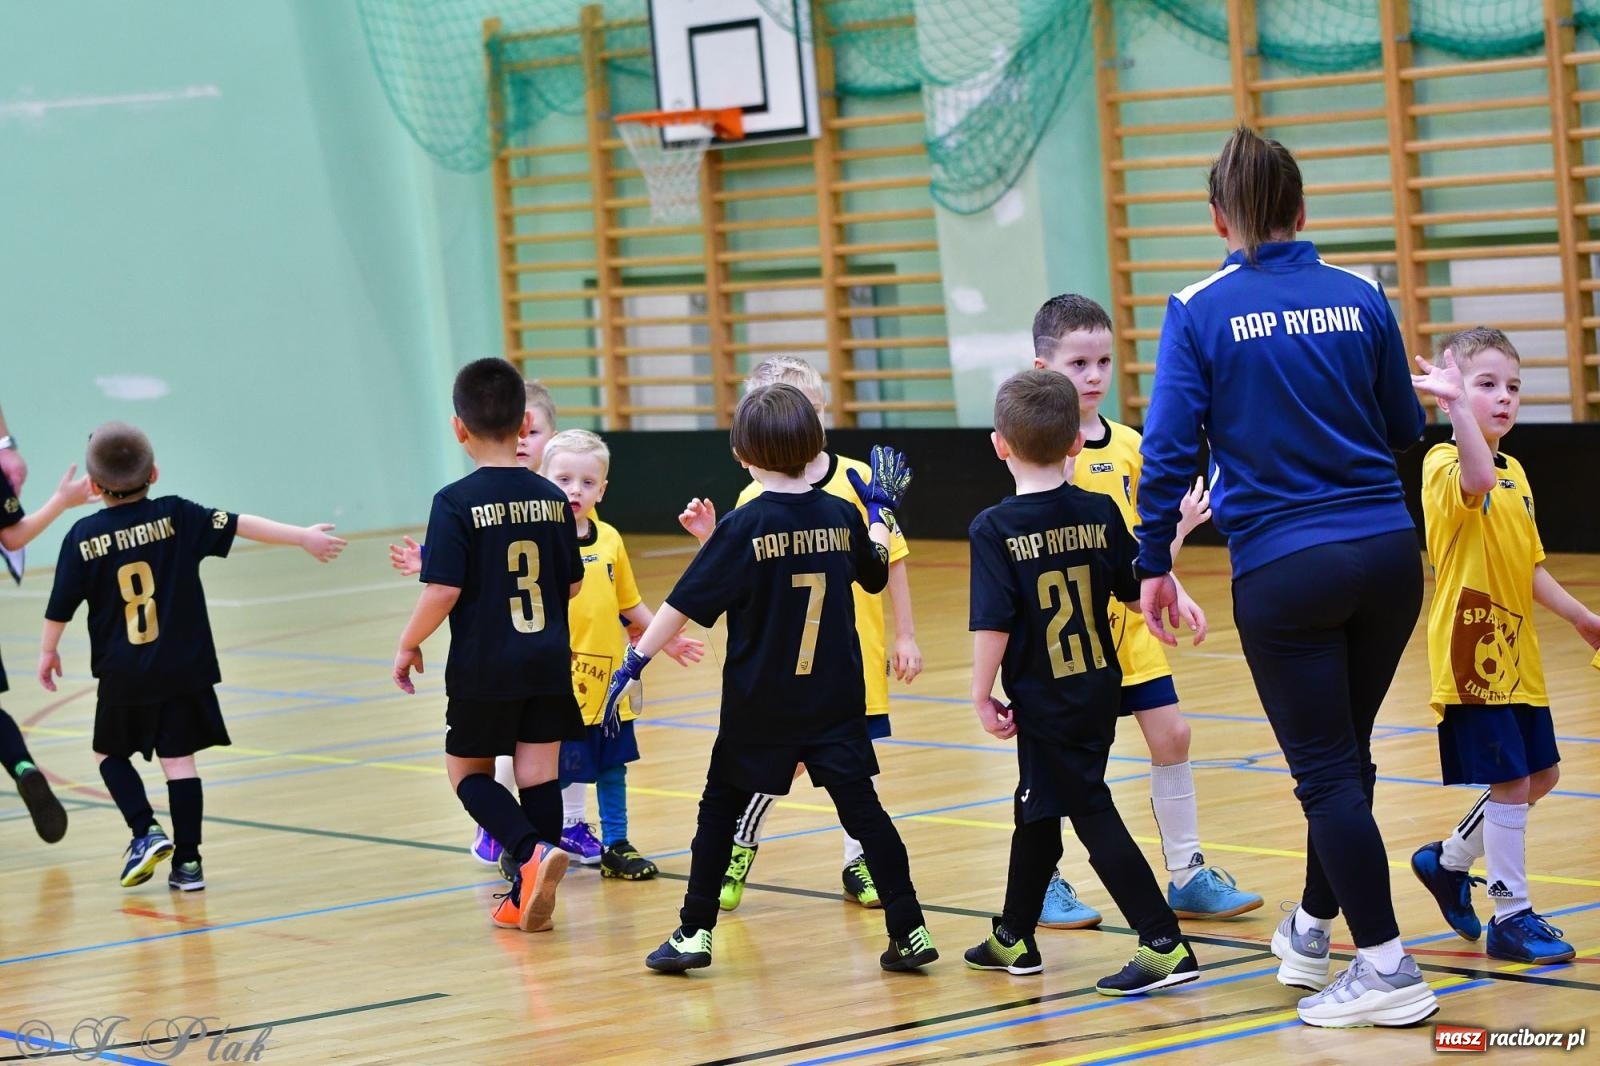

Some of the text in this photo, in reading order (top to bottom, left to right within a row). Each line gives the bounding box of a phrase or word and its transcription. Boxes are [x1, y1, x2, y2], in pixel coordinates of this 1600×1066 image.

[1230, 306, 1364, 343] RAP RYBNIK
[471, 499, 566, 529] RAP RYBNIK
[79, 533, 112, 562] RAP
[116, 516, 175, 551] RYBNIK
[752, 527, 852, 562] RAP RYBNIK
[1006, 524, 1107, 562] RAP RYBNIK
[117, 561, 159, 645] 8
[507, 541, 546, 634] 3
[791, 572, 827, 676] 7
[1037, 564, 1108, 679] 21
